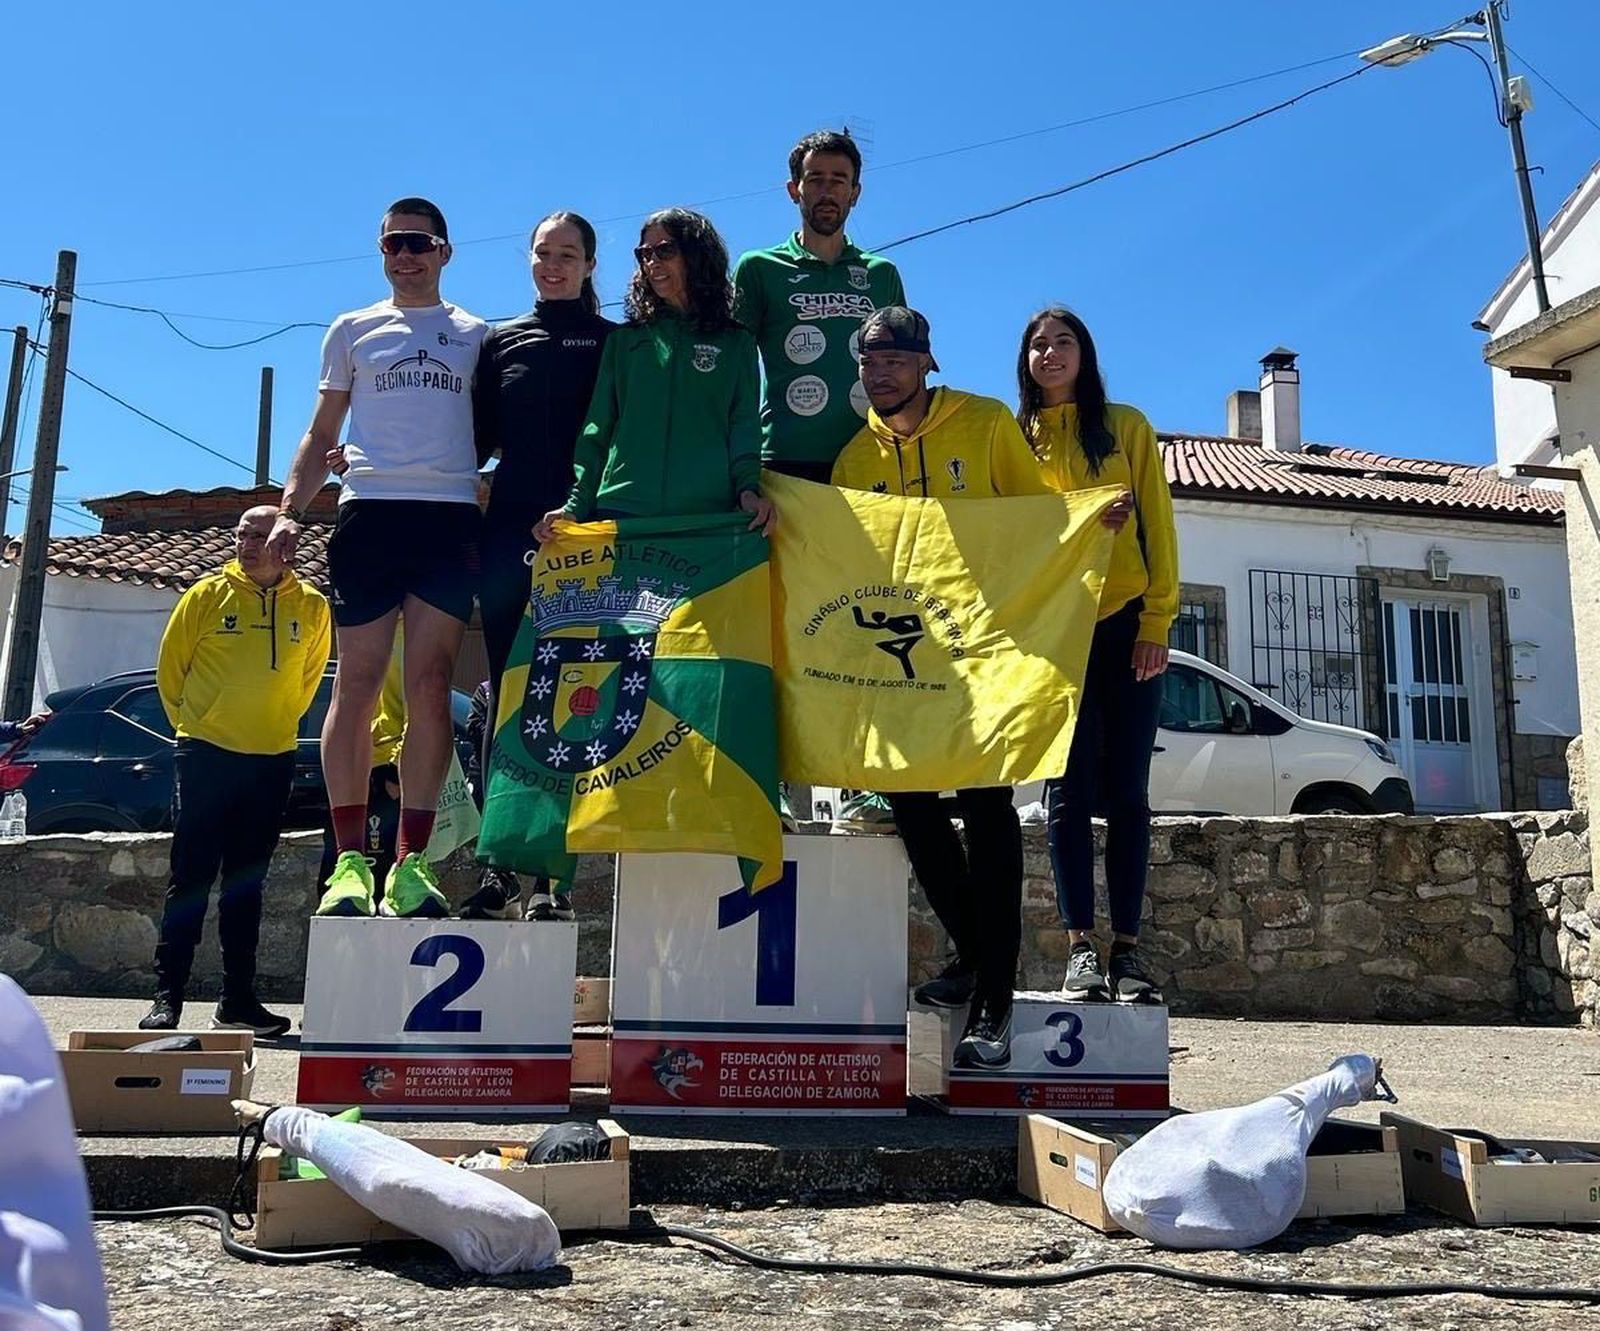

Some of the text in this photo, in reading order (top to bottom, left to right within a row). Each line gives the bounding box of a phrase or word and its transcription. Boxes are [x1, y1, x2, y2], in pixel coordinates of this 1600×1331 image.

[789, 293, 874, 310] CHINCA
[562, 339, 597, 347] OYSHO
[375, 370, 462, 393] CECINAS PABLO
[538, 548, 594, 577] UBE
[600, 542, 702, 578] ATLÉTICO
[854, 585, 898, 599] CLUBE
[904, 589, 922, 602] DE
[804, 667, 841, 681] FUNDADO
[842, 675, 856, 686] EM
[866, 679, 878, 687] DE
[880, 680, 915, 688] AGOSTO
[542, 776, 568, 795] DE
[575, 720, 693, 796] CAVALEIROS
[718, 860, 798, 1007] 1
[403, 934, 485, 1033] 2
[1043, 1011, 1086, 1068] 3
[720, 1051, 881, 1067] FEDERACIÓN DE ATLETISMO
[406, 1066, 513, 1076] FEDERACIÓN DE ATLETISMO
[720, 1068, 881, 1082] DE CASTILLA Y LEÓN
[405, 1076, 513, 1086] DE CASTILLA Y LEÓN
[404, 1087, 512, 1097] DELEGACIÓN DE ZAMORA
[719, 1084, 880, 1099] DELEGACIÓN DE ZAMORA
